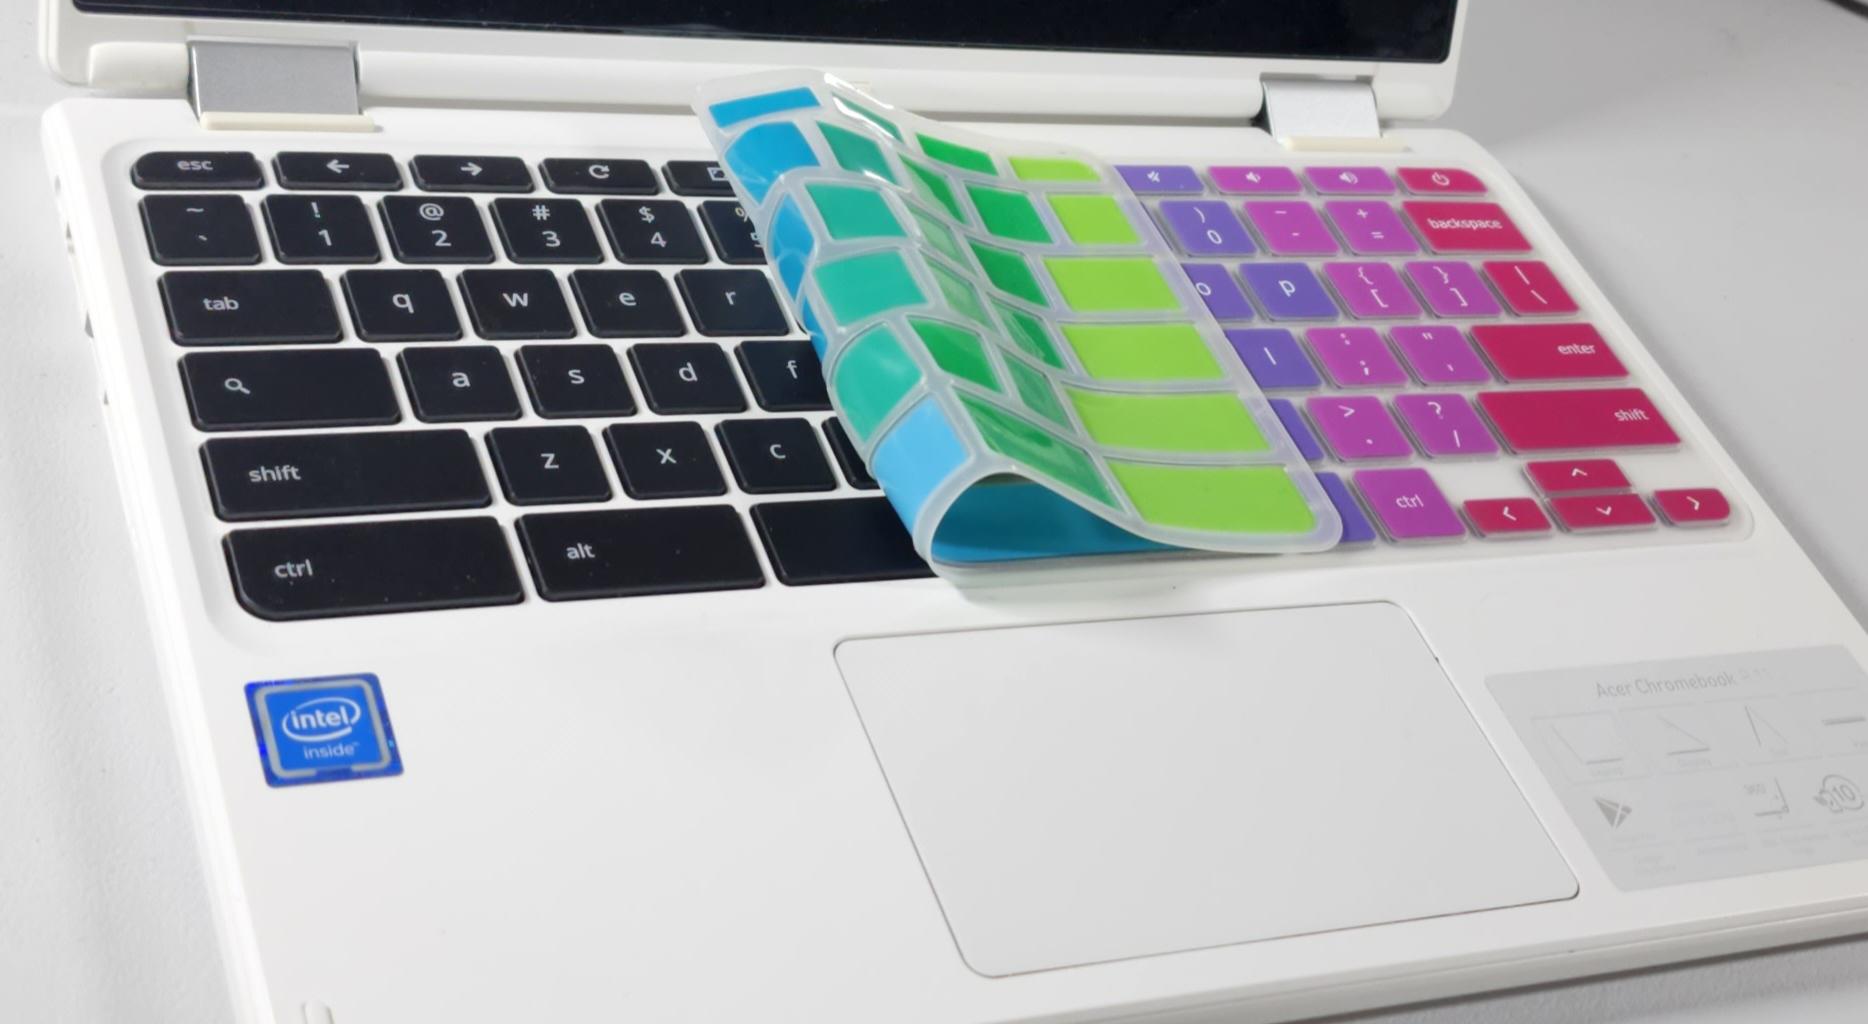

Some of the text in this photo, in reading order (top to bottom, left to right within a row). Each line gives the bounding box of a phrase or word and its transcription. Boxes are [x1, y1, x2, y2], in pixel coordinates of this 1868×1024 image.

[176, 160, 214, 171] esc
[310, 201, 321, 219] !
[418, 202, 445, 221] @
[531, 204, 551, 221] #
[638, 205, 655, 224] $
[1427, 218, 1503, 231] backspace
[318, 229, 332, 247] 1
[431, 229, 452, 247] 2
[542, 230, 561, 248] 3
[650, 231, 667, 248] 4
[1370, 231, 1385, 240] =
[202, 296, 240, 311] tab
[392, 293, 415, 314] q
[502, 292, 529, 308] w
[618, 292, 637, 307] e
[725, 291, 737, 306] r
[1557, 343, 1596, 355] enter
[567, 369, 585, 385] s
[678, 361, 698, 382] d
[786, 359, 798, 379] f
[451, 371, 471, 388] a
[1427, 401, 1444, 420] ?
[1614, 408, 1649, 422] shift
[656, 448, 677, 465] x
[769, 443, 786, 460] c
[540, 453, 560, 469] z
[248, 464, 302, 483] shift
[1395, 494, 1424, 509] ctrl
[566, 542, 596, 560] alt
[274, 558, 313, 579] ctrl
[1596, 682, 1633, 699] Acer
[1634, 671, 1738, 695] Chromebook
[290, 705, 350, 730] intel
